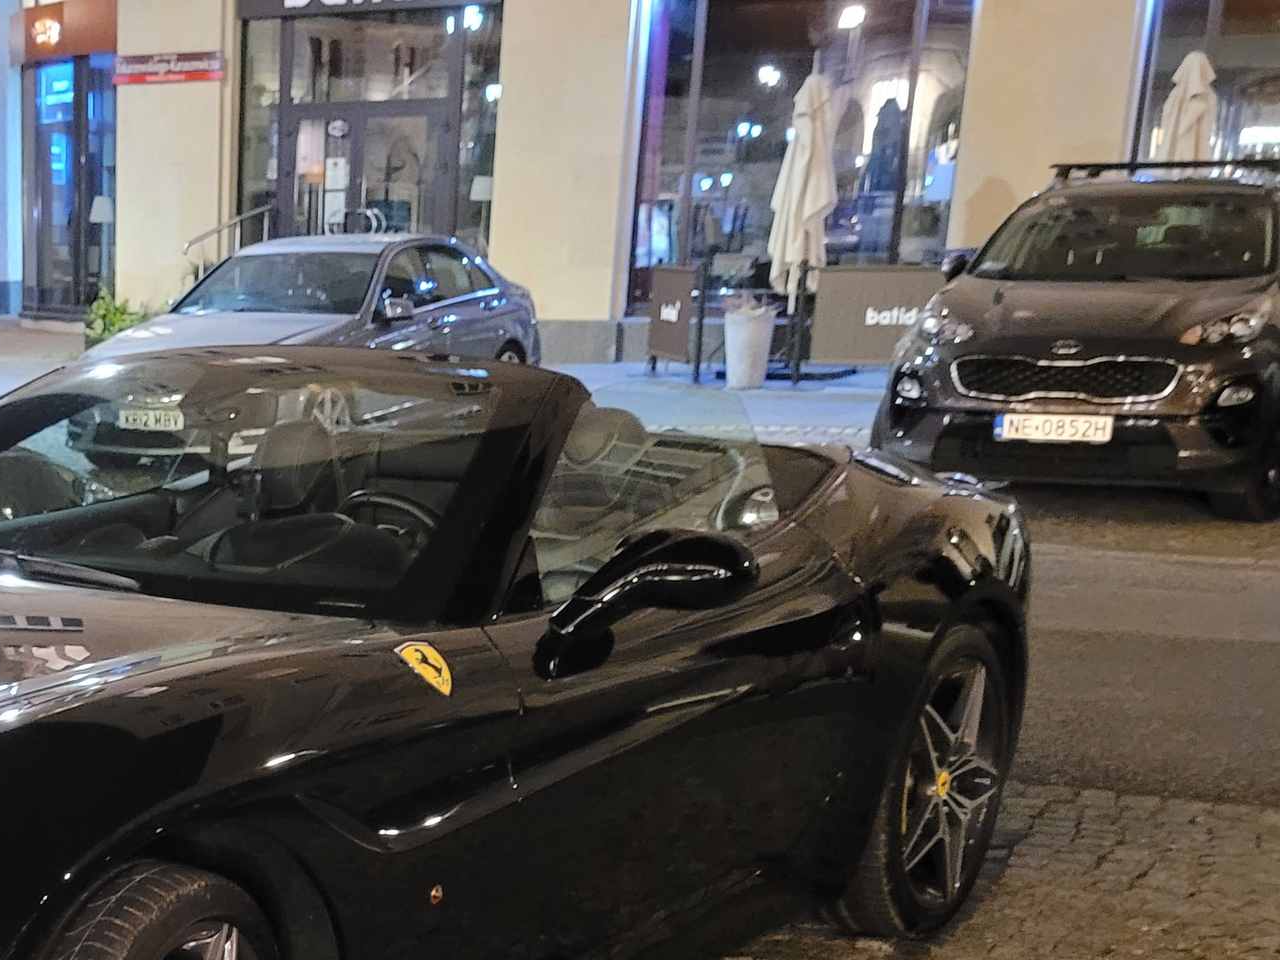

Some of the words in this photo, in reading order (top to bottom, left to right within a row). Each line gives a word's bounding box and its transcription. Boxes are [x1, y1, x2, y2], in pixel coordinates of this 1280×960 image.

[864, 306, 919, 326] batid
[1008, 419, 1033, 436] NE
[1042, 419, 1107, 438] 0852H
